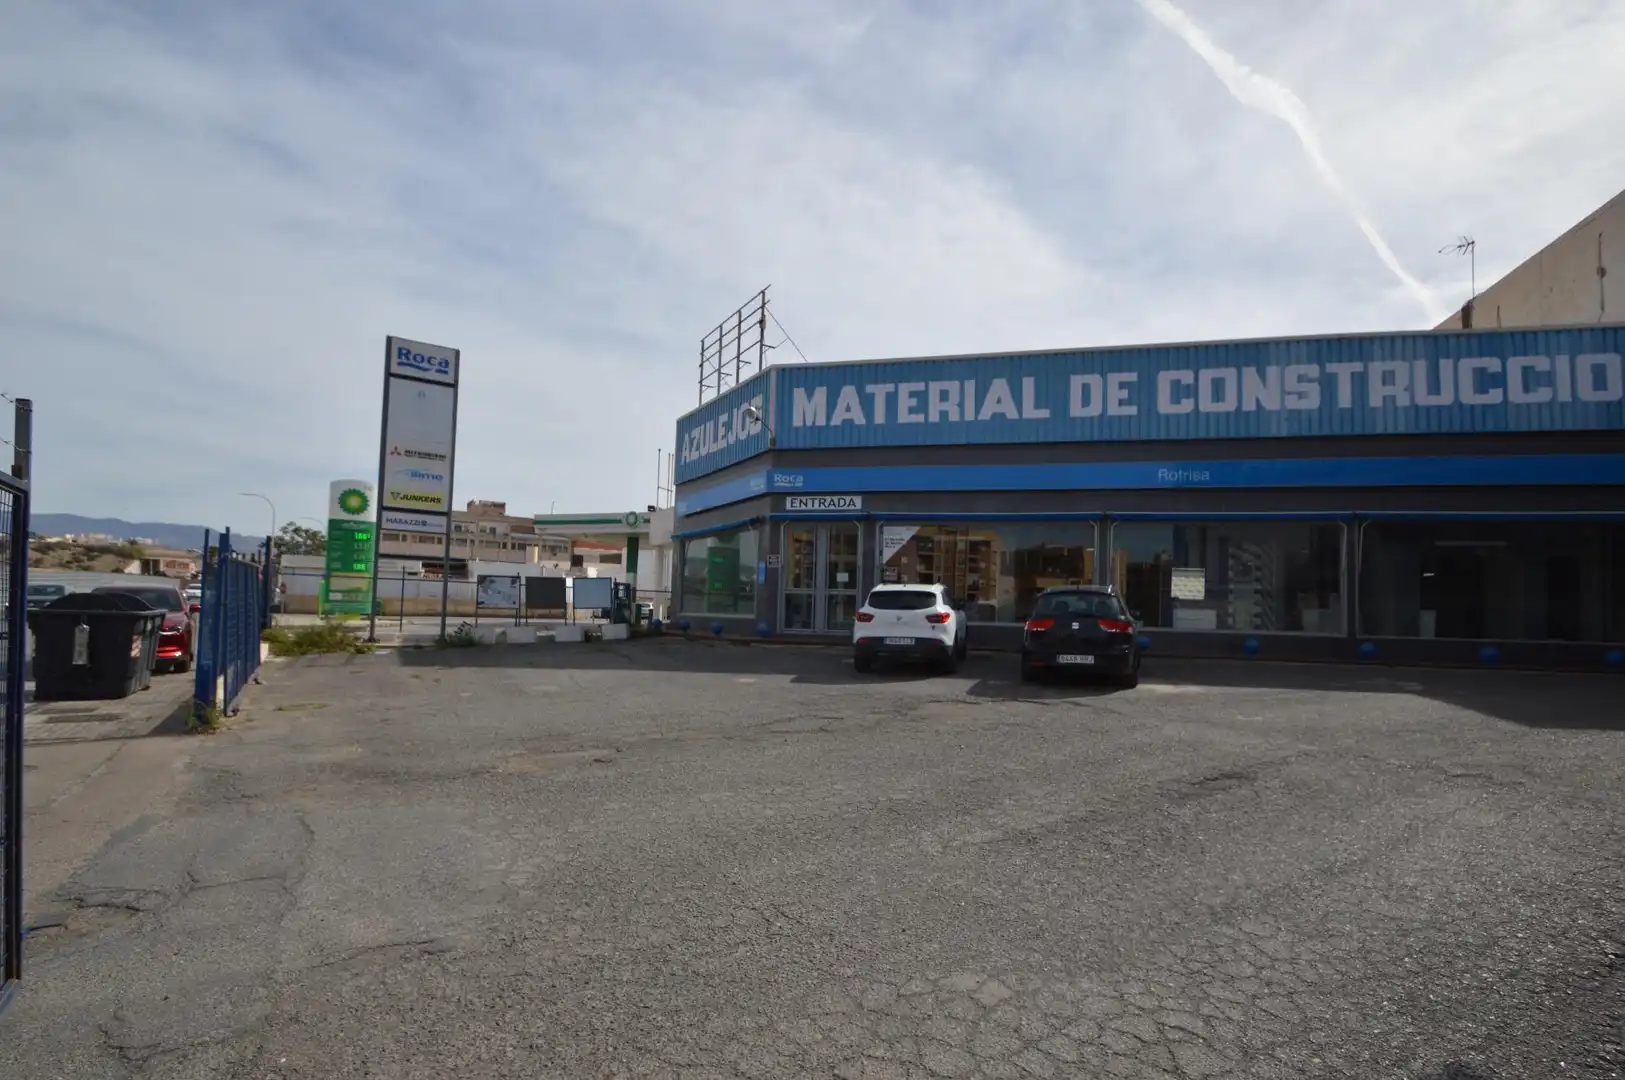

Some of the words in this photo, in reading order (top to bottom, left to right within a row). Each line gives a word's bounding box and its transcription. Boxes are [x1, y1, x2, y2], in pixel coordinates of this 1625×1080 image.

[397, 346, 449, 369] Roca
[792, 376, 1050, 427] MATERIAL
[1069, 372, 1138, 417] DE
[1156, 353, 1623, 414] CONSTRUCCIO
[774, 473, 804, 483] Roca
[400, 494, 441, 504] JUNKERS
[789, 496, 857, 509] ENTRADA
